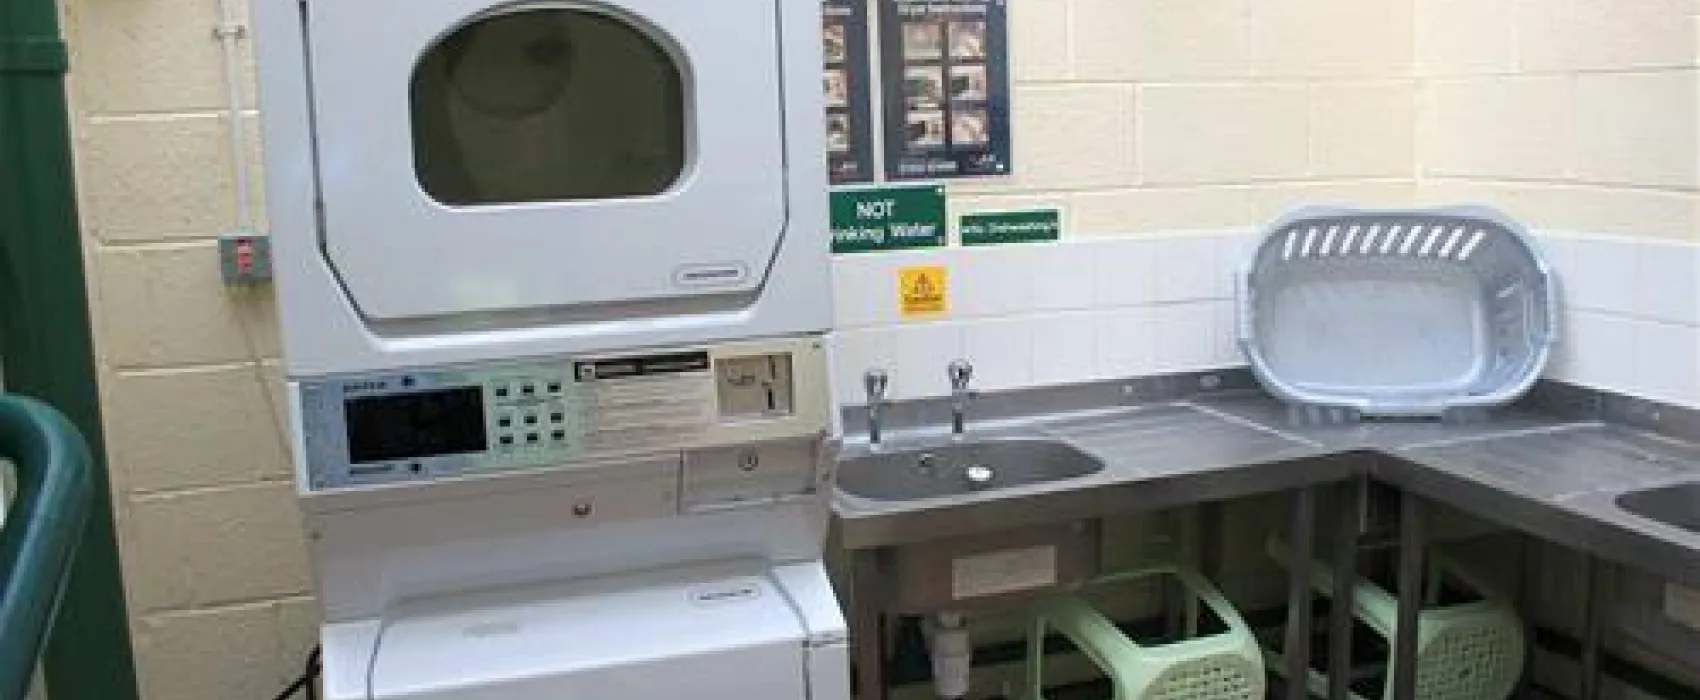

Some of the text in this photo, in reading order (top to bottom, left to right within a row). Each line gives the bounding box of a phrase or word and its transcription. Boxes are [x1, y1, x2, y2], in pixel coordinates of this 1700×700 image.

[856, 198, 895, 219] NOT
[828, 222, 936, 244] inking Water
